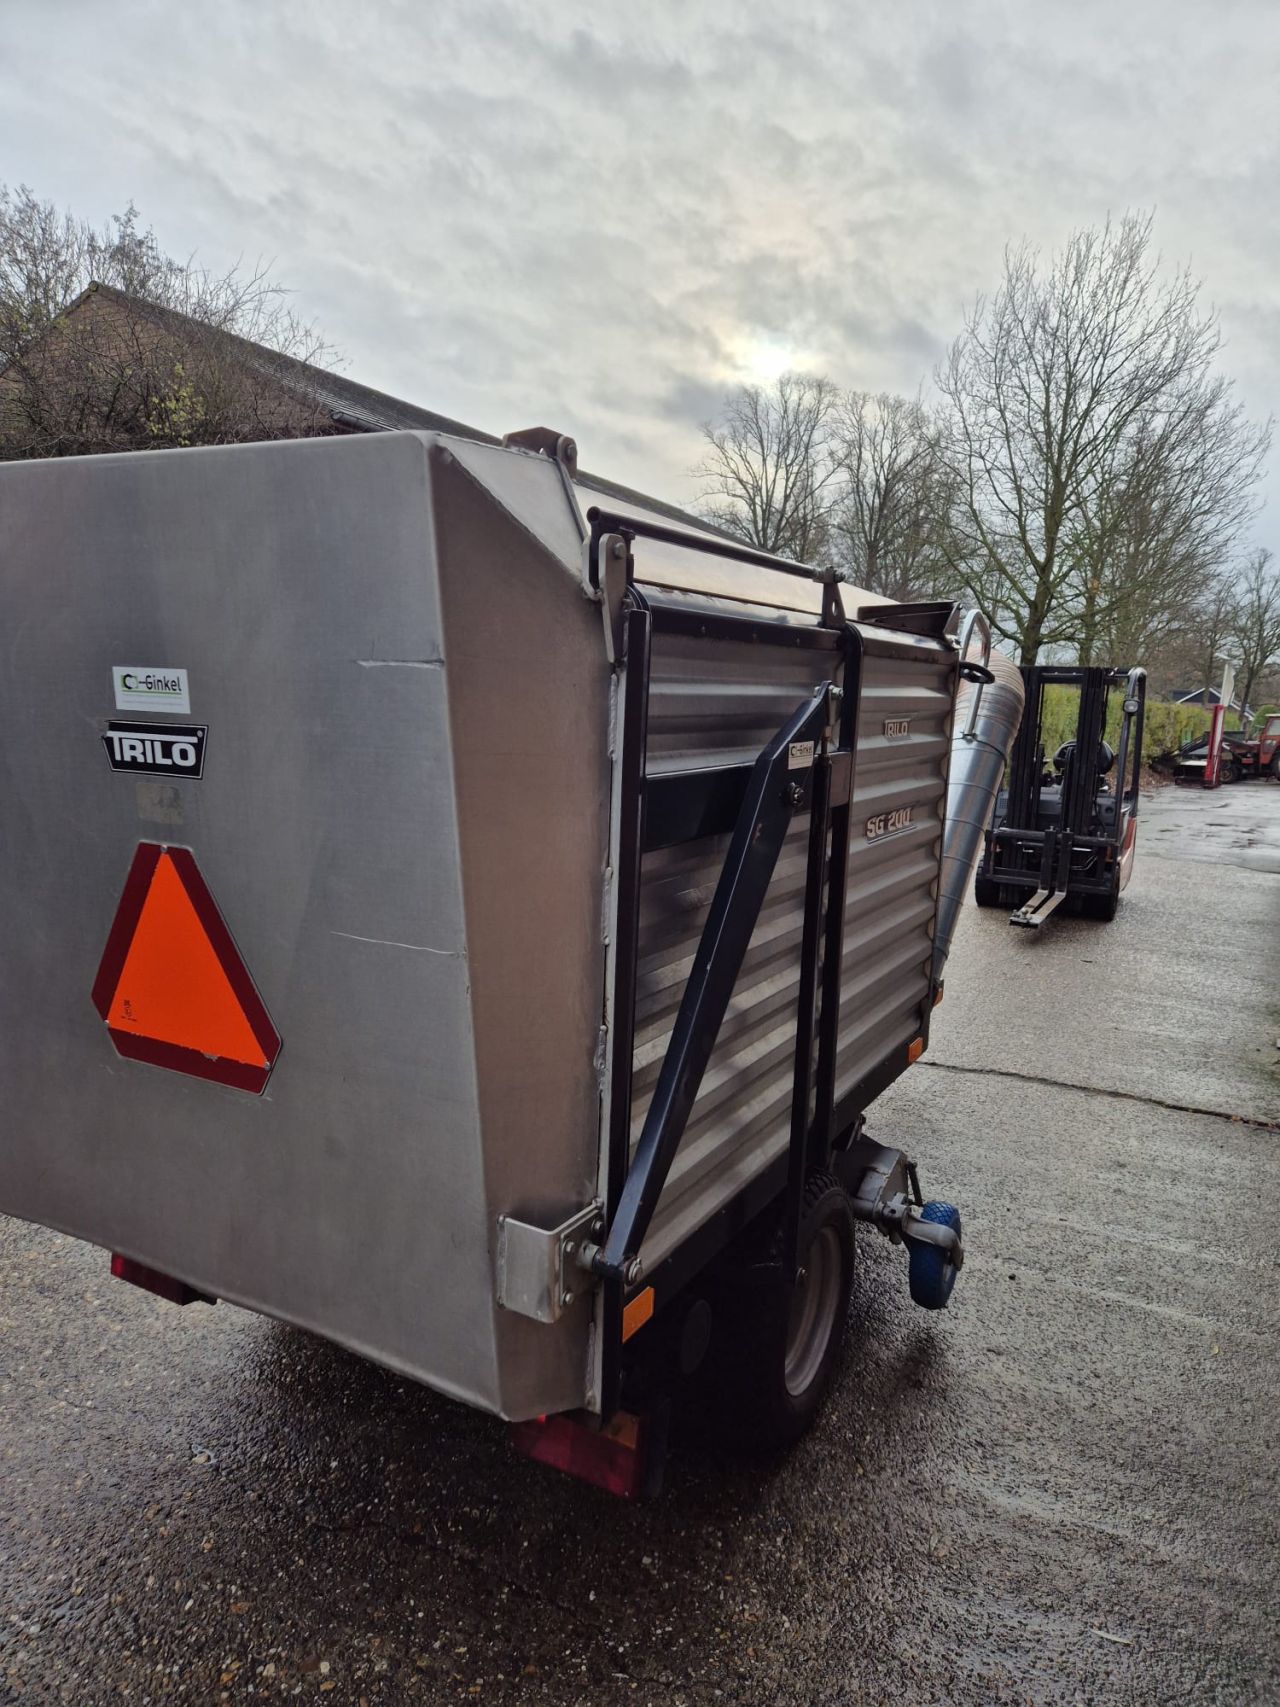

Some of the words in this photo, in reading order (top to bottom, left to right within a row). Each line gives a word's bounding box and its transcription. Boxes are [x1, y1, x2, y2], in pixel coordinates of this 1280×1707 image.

[106, 731, 198, 767] TRILO
[866, 815, 885, 838] SG
[888, 807, 911, 831] 200
